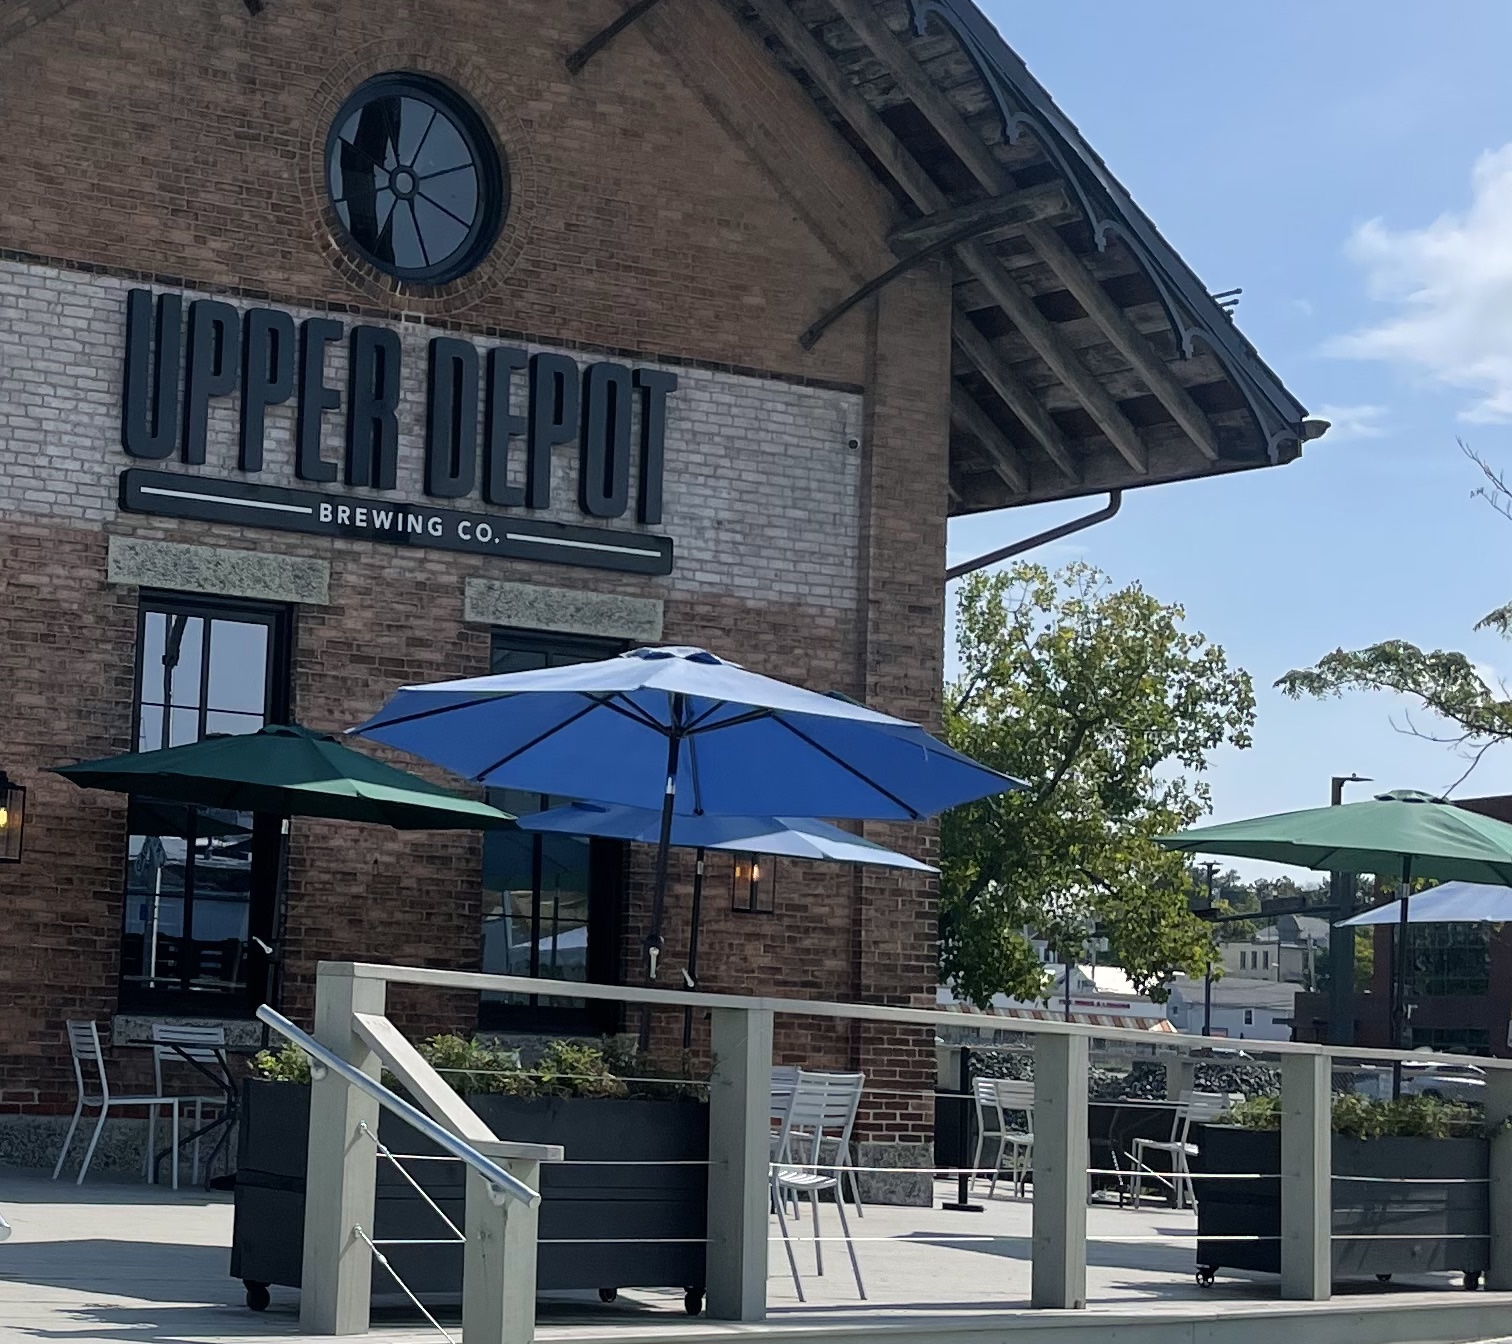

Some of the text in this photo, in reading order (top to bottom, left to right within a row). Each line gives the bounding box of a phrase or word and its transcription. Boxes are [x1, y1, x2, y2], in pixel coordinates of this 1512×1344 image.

[121, 289, 678, 525] UPPER DEPOT
[319, 503, 500, 544] BREWING CO.
